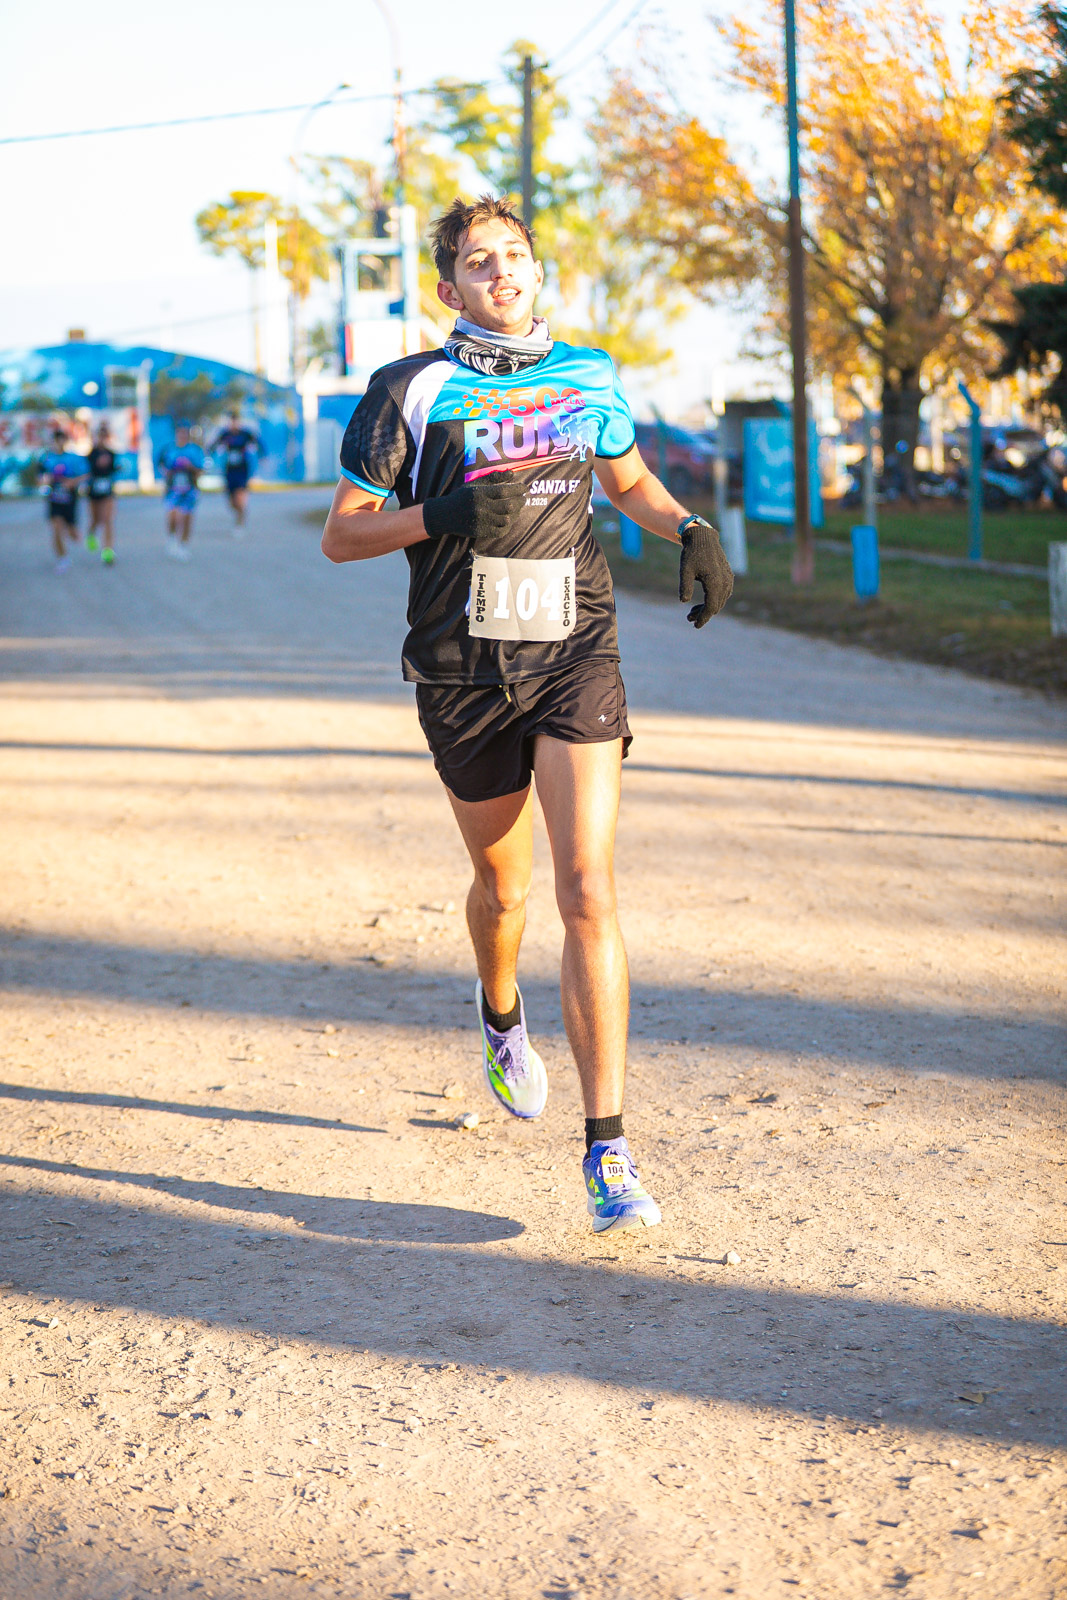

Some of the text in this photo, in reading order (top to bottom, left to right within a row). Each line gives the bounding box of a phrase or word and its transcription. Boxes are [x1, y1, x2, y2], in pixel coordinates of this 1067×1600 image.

[464, 414, 574, 467] RUN
[530, 479, 566, 494] SANTA
[475, 573, 486, 622] TIEMPO
[493, 577, 562, 620] 104
[562, 576, 571, 627] EXACTO
[607, 1165, 624, 1174] 104
